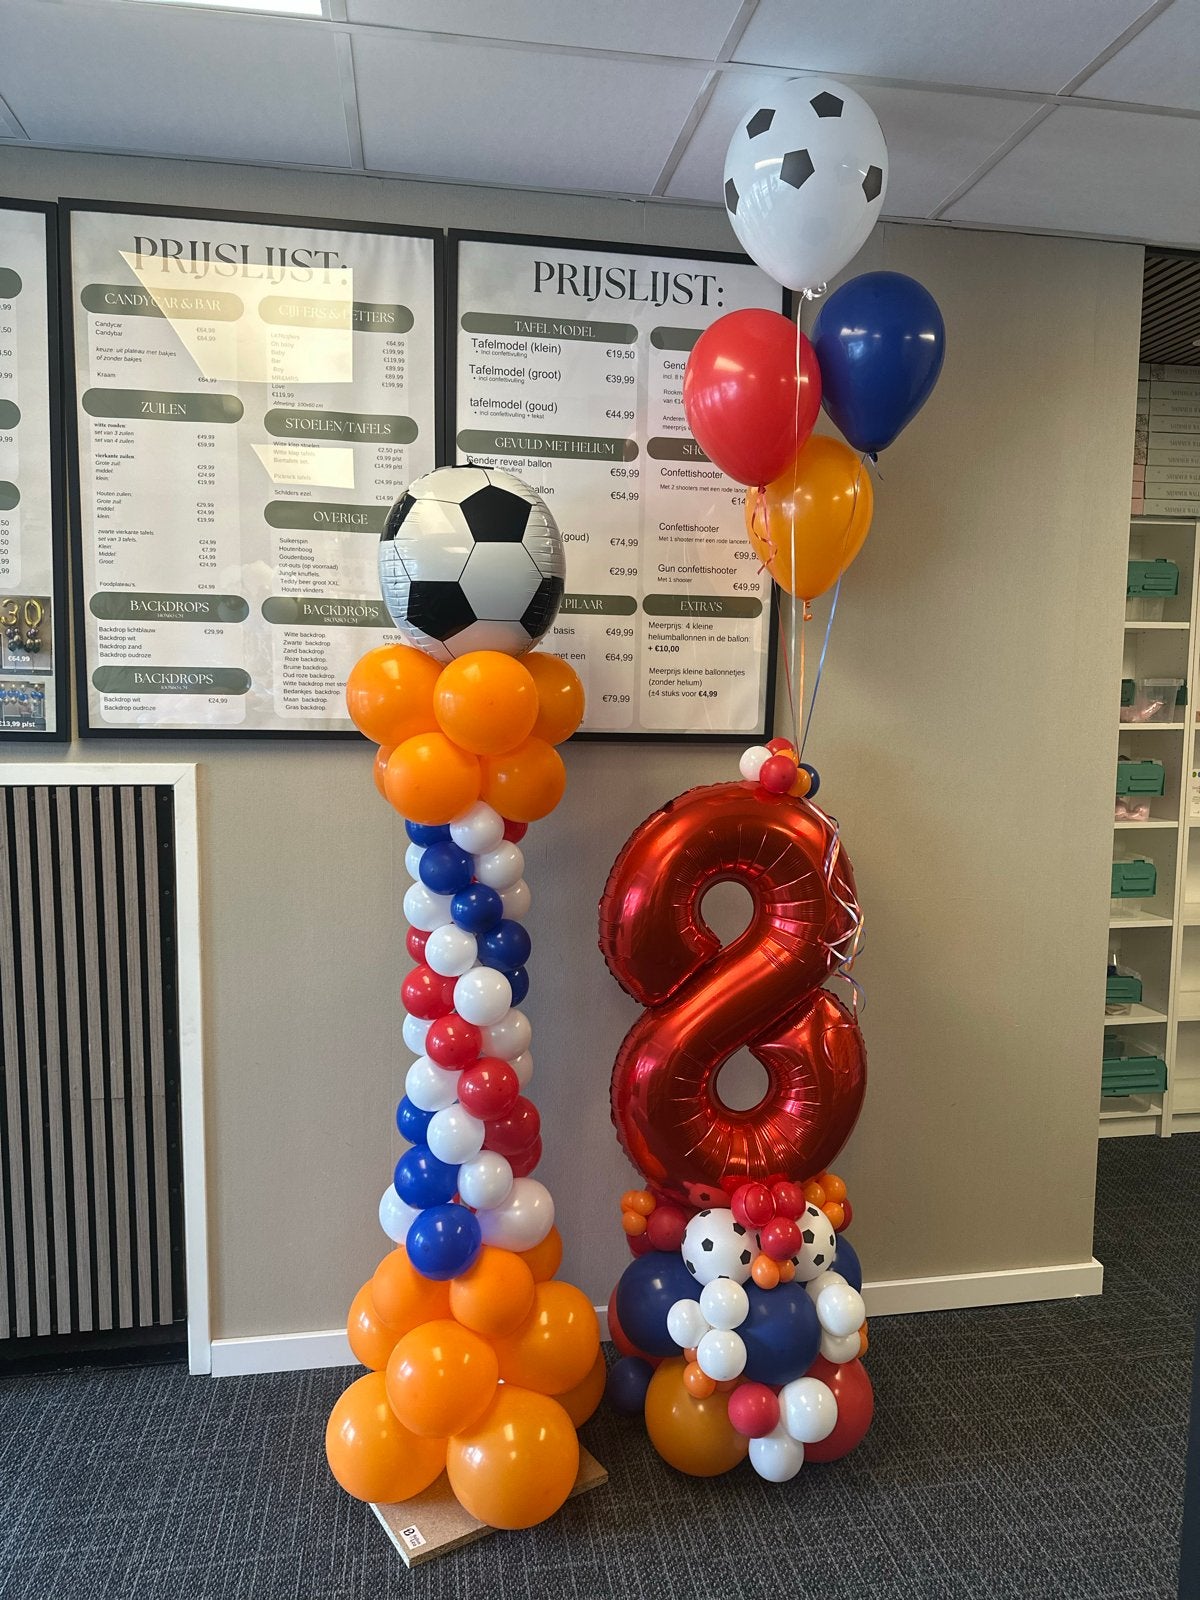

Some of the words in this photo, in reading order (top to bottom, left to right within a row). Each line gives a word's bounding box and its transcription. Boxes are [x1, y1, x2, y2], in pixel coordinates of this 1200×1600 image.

[133, 236, 348, 286] PRIJSLIJST:
[534, 260, 724, 308] PRIJSLIJST:
[194, 300, 221, 311] BAR
[514, 320, 550, 334] TAFEL
[552, 325, 596, 338] MODEL
[471, 338, 528, 352] Tafelmodel
[530, 342, 562, 356] (klein)
[606, 350, 635, 359] €19,50
[469, 364, 525, 377] Tafelmodel
[528, 368, 562, 381] (groot)
[606, 375, 635, 384] €39,99
[141, 401, 186, 415] ZUILEN
[470, 398, 522, 410] tafelmodel
[525, 401, 558, 413] (goud)
[606, 410, 635, 419] €44,99
[494, 437, 543, 450] GEVULD
[545, 440, 570, 452] MET
[571, 442, 615, 454] HELIUM
[500, 457, 525, 467] reveal
[528, 459, 552, 468] ballon
[610, 468, 640, 478] €59,99
[660, 468, 723, 479] Confettishooter
[611, 492, 639, 501] €54,99
[314, 511, 368, 525] OVERIGE
[659, 523, 719, 532] Confettishooter
[561, 532, 589, 543] (goud)
[610, 538, 639, 547] €74,99
[610, 568, 638, 576] €29,99
[658, 564, 675, 572] Gun
[678, 564, 737, 574] confettishooter
[733, 583, 760, 591] €49,99
[130, 600, 210, 613] BACKDROPS
[565, 599, 603, 610] PILAAR
[680, 601, 723, 612] EXTRA'S
[304, 604, 379, 617] BACKDROPS
[648, 622, 684, 630] Meerprijs:
[606, 628, 634, 637] €49,99
[648, 634, 706, 642] heliumballonnen
[606, 654, 633, 662] €64,99
[649, 667, 681, 676] Meerprijs
[705, 668, 745, 676] ballonnetjes
[134, 673, 214, 684] BACKDROPS
[602, 694, 630, 703] €79,99
[698, 690, 718, 698] €4,99
